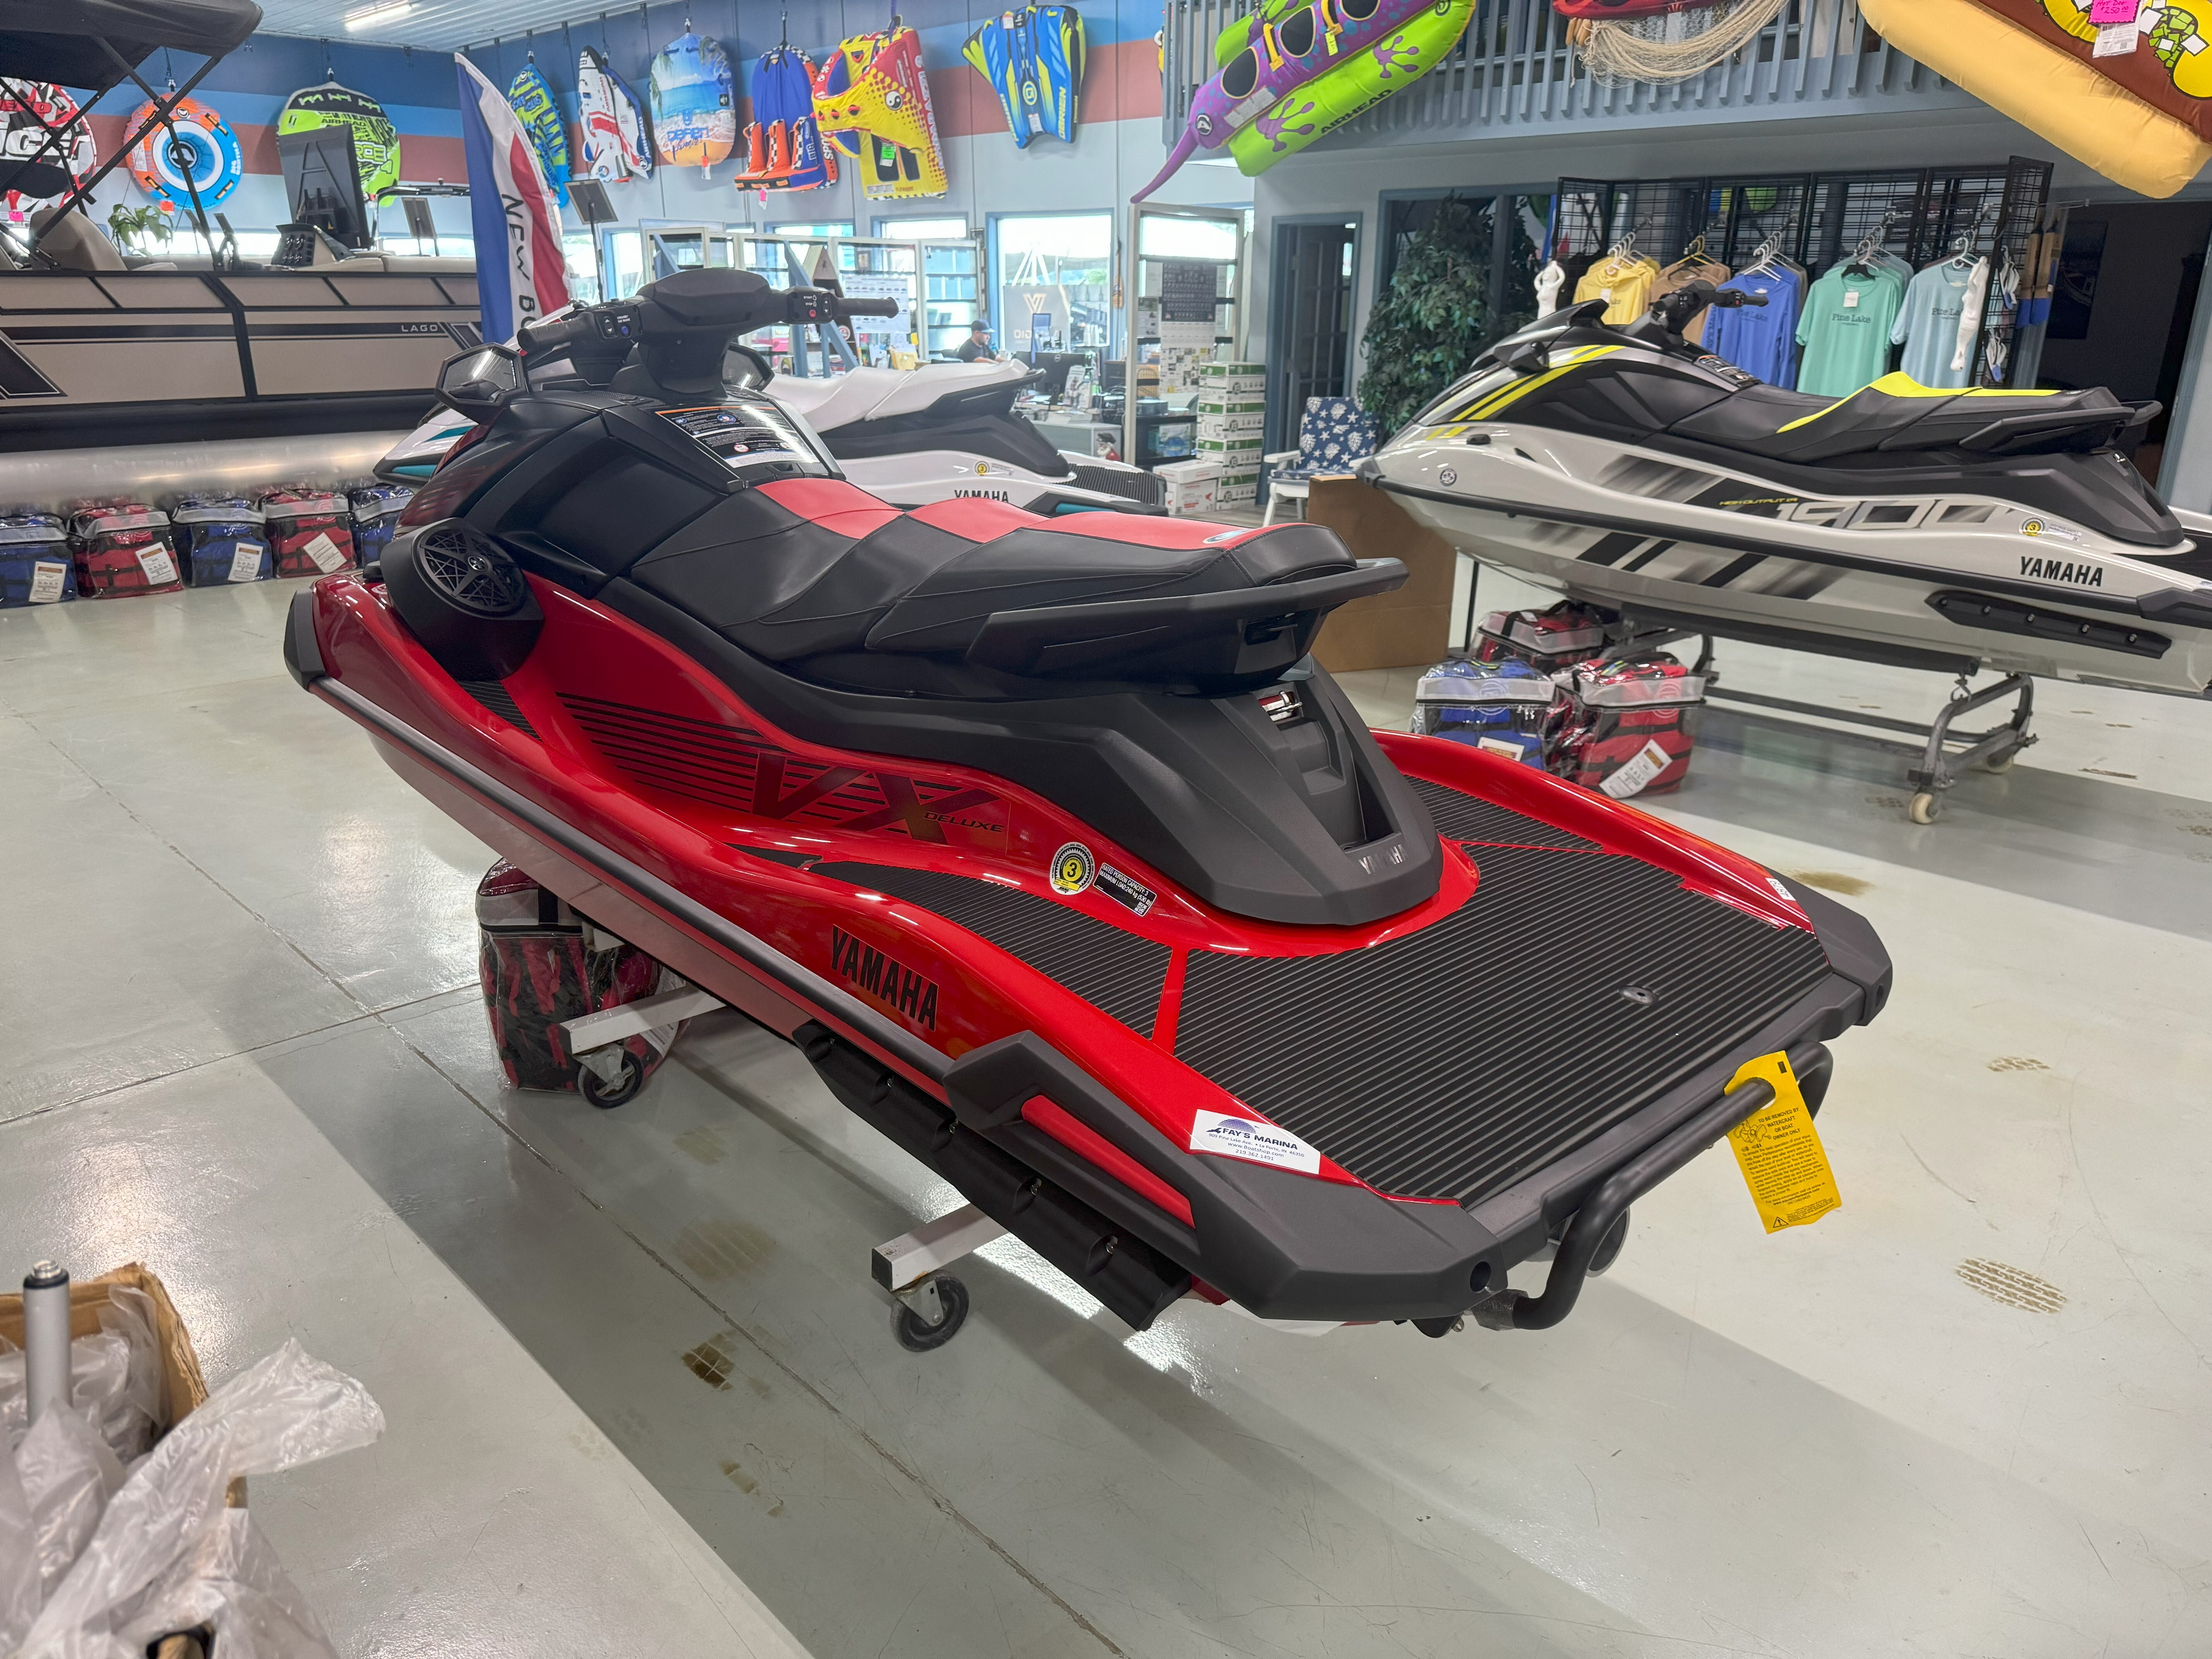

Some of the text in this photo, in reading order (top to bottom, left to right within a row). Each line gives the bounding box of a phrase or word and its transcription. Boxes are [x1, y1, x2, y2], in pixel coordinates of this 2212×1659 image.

[501, 194, 530, 281] NEW
[1831, 314, 1872, 323] Pine Lake
[954, 489, 1009, 503] YAMAHA
[2020, 556, 2103, 587] YAMAHA
[752, 753, 1002, 845] VX
[924, 812, 1005, 833] DELUXE
[1067, 862, 1077, 878] 3
[1099, 870, 1117, 884] MAXIMUM
[1102, 864, 1113, 874] RATED
[1113, 871, 1127, 883] PERSON
[1127, 879, 1145, 895] CAPACITY:
[831, 926, 939, 1032] YAMAHA
[1766, 1115, 1795, 1127] WATERCRAFT
[1771, 1109, 1793, 1119] REMOVED
[1223, 1128, 1298, 1150] FAY'S MARINA
[1773, 1132, 1789, 1140] OWNER
[1228, 1142, 1284, 1158] www.Boatshop.com
[1235, 1149, 1274, 1161] 219.362.1491
